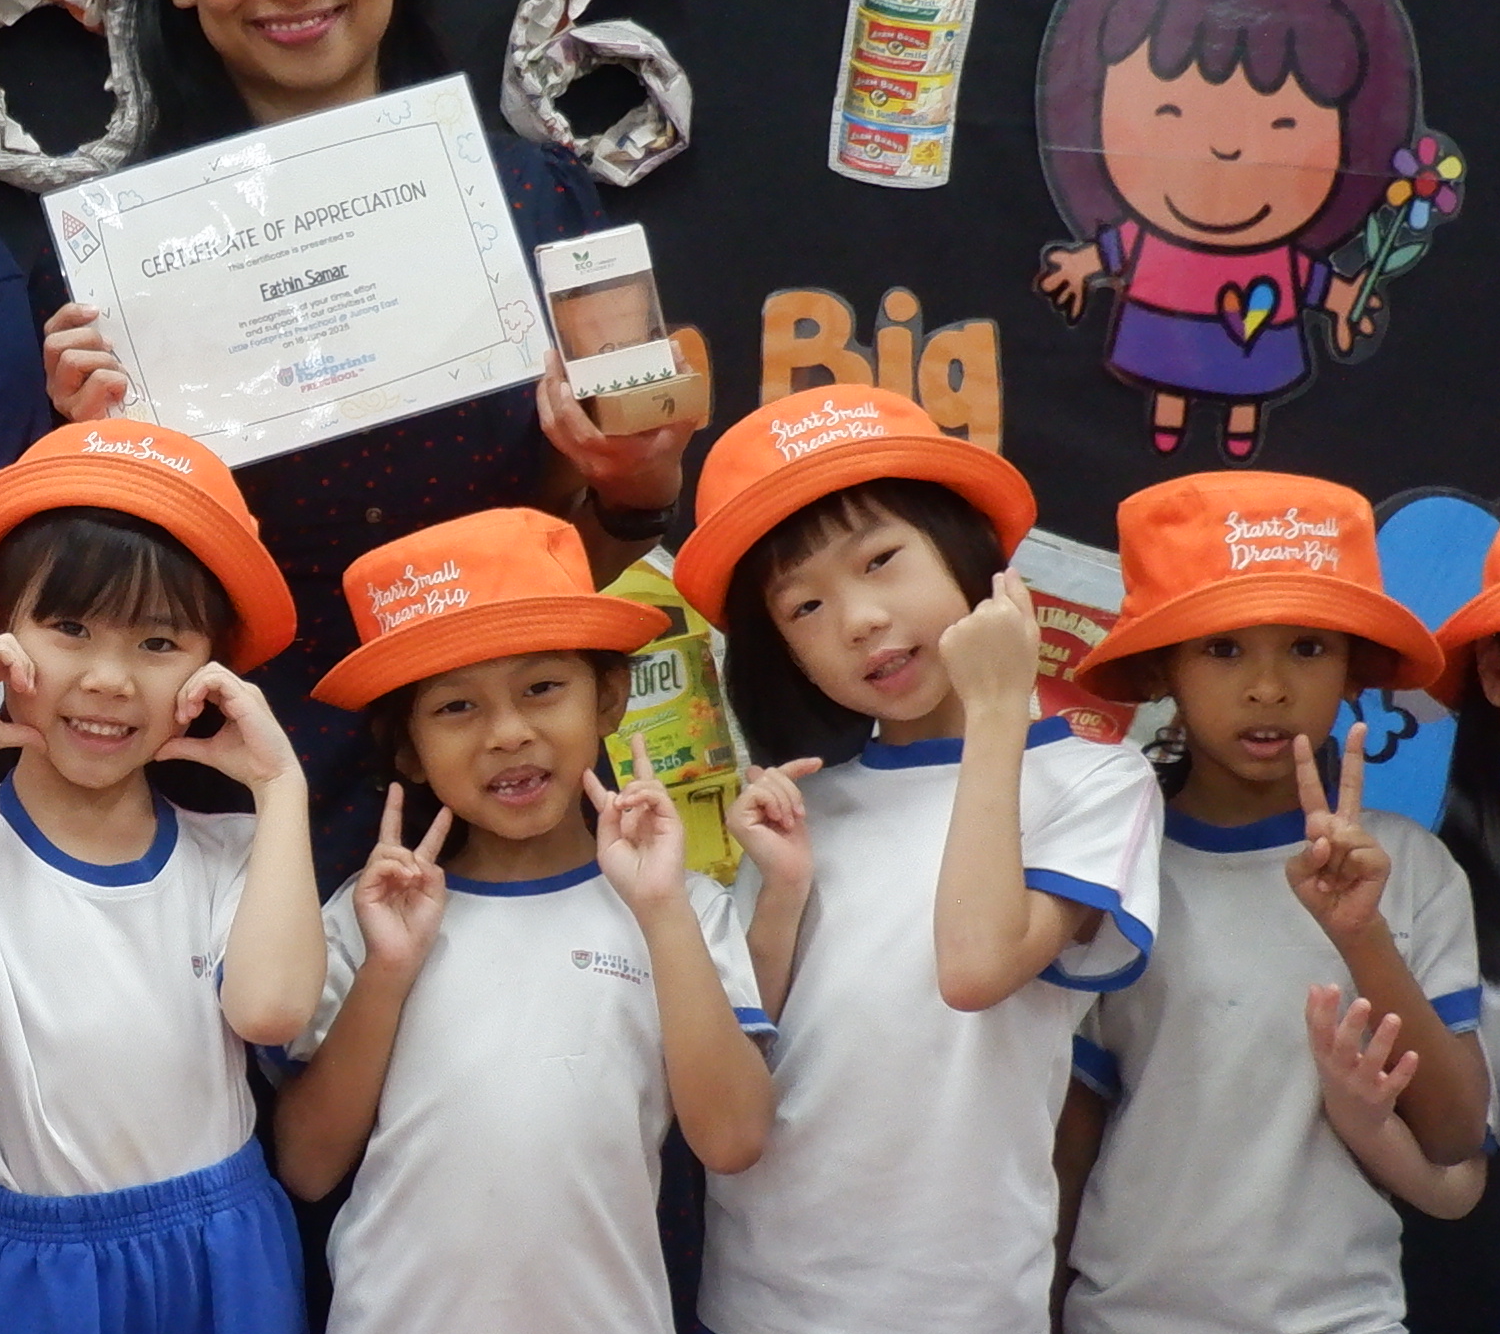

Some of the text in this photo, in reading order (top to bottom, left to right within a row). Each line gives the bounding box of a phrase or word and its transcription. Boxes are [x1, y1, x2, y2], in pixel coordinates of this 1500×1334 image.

[263, 219, 286, 242] OF
[294, 180, 427, 234] APPRECIATION
[246, 248, 291, 268] certificate
[301, 235, 344, 253] presented
[345, 230, 355, 239] to
[304, 264, 347, 286] Samar
[245, 327, 263, 338] and
[327, 296, 366, 314] activities
[310, 297, 329, 312] your
[353, 282, 377, 296] effort
[762, 290, 1000, 462] Big
[83, 431, 192, 475] Start Small
[1224, 507, 1339, 543] Start Small
[1230, 540, 1339, 573] Dream Big
[628, 653, 682, 700] urel
